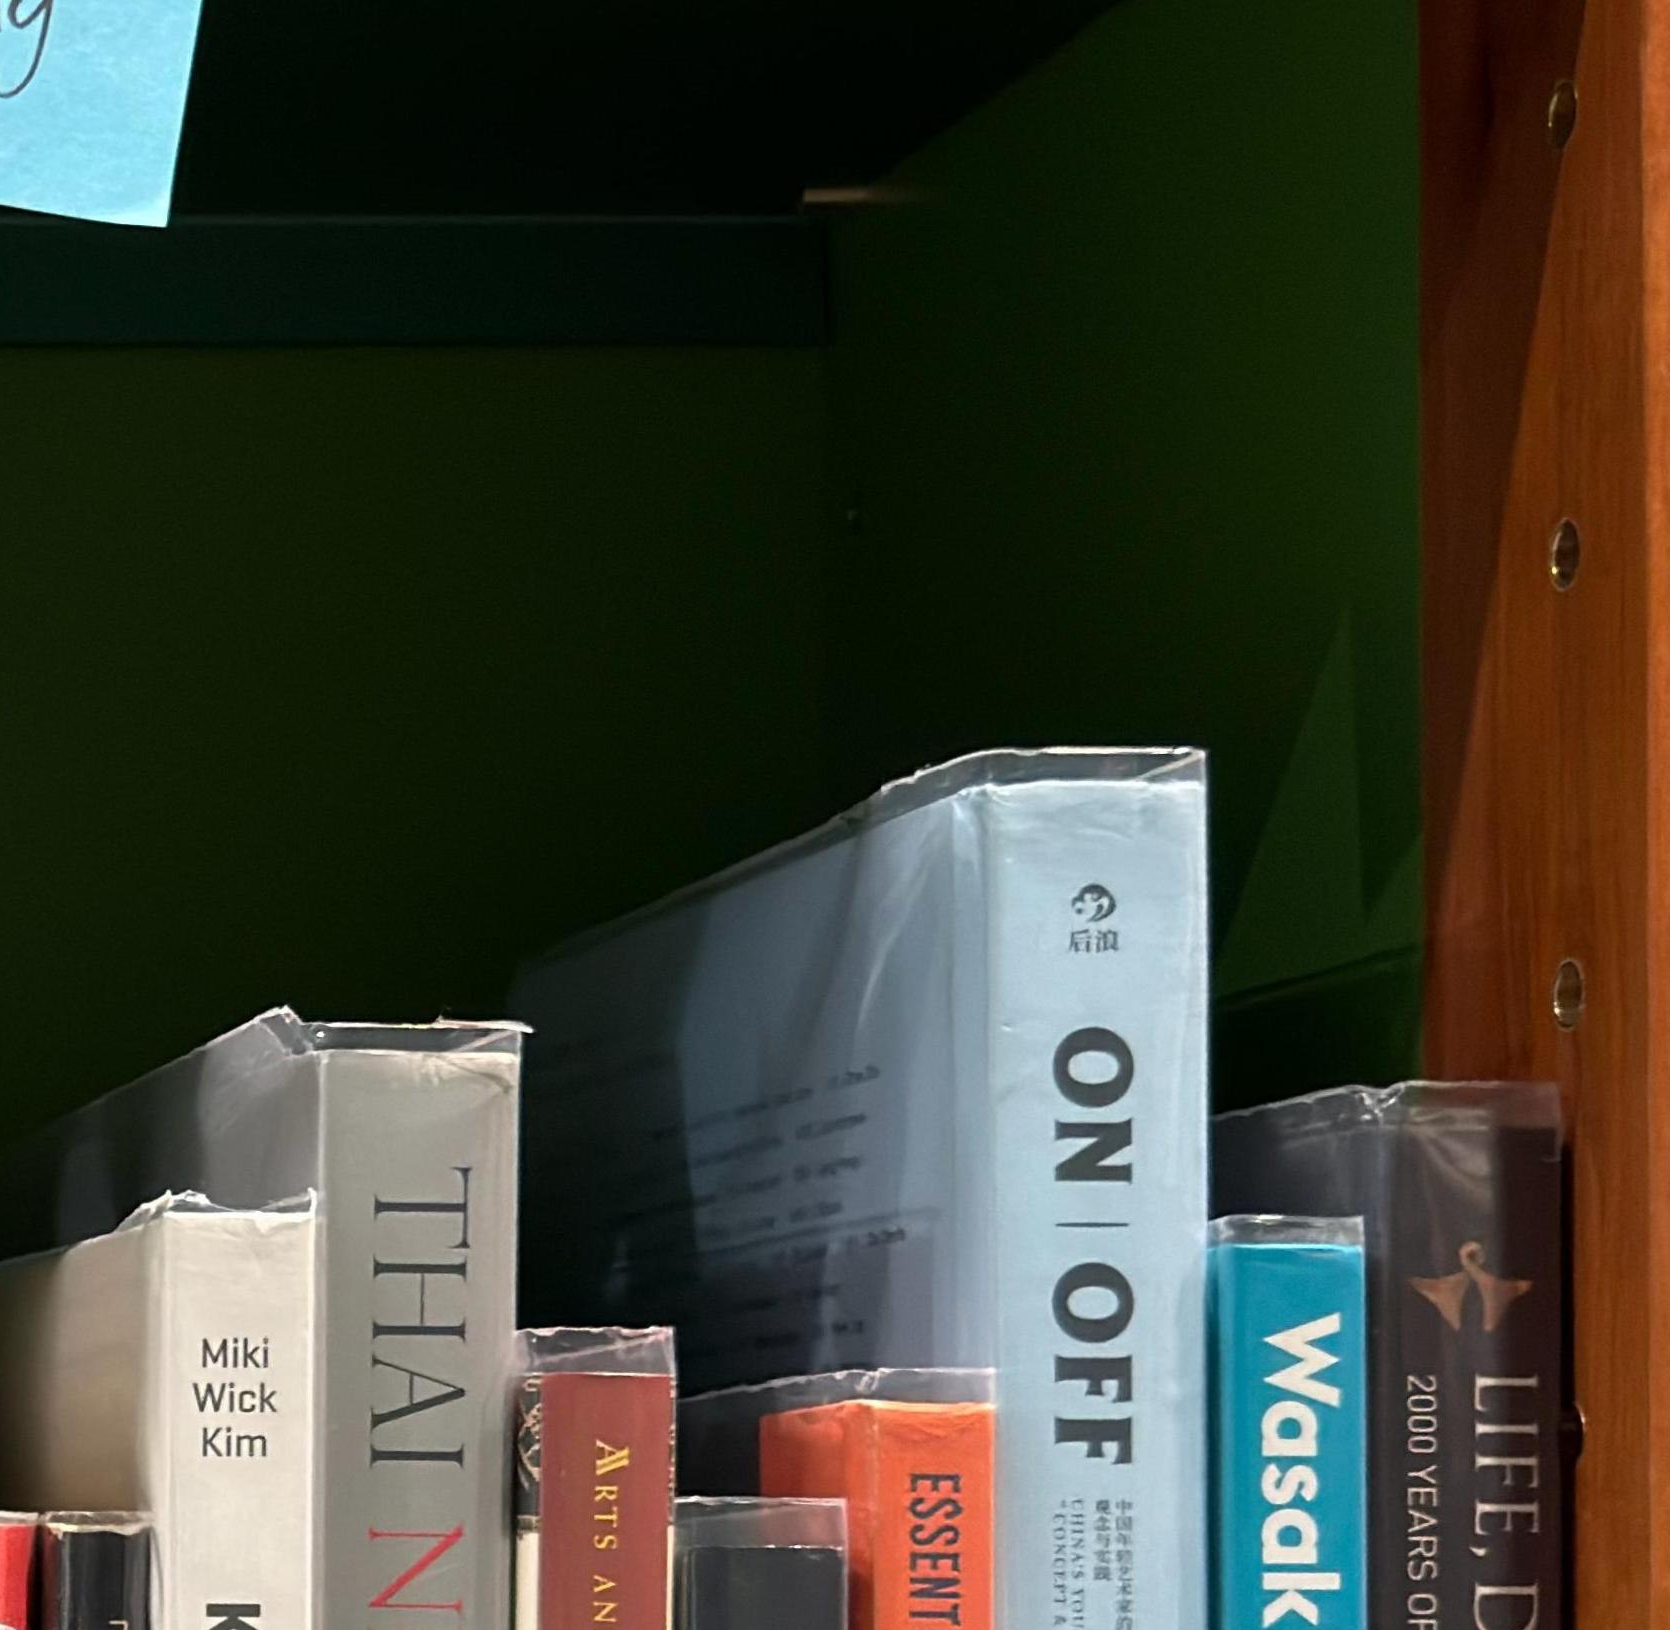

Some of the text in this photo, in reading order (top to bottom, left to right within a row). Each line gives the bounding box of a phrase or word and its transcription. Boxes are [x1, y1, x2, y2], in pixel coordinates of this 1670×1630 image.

[1068, 928, 1119, 953] 后浪
[1051, 1025, 1136, 1466] ON OFF
[199, 1337, 271, 1368] Miki
[370, 1165, 470, 1468] THAI
[191, 1381, 277, 1413] Wick
[201, 1426, 268, 1457] Kim
[1407, 1375, 1438, 1455] 2000
[593, 1440, 628, 1549] ARTS
[1471, 1375, 1542, 1561] LIFE,
[1405, 1463, 1438, 1582] YEARS
